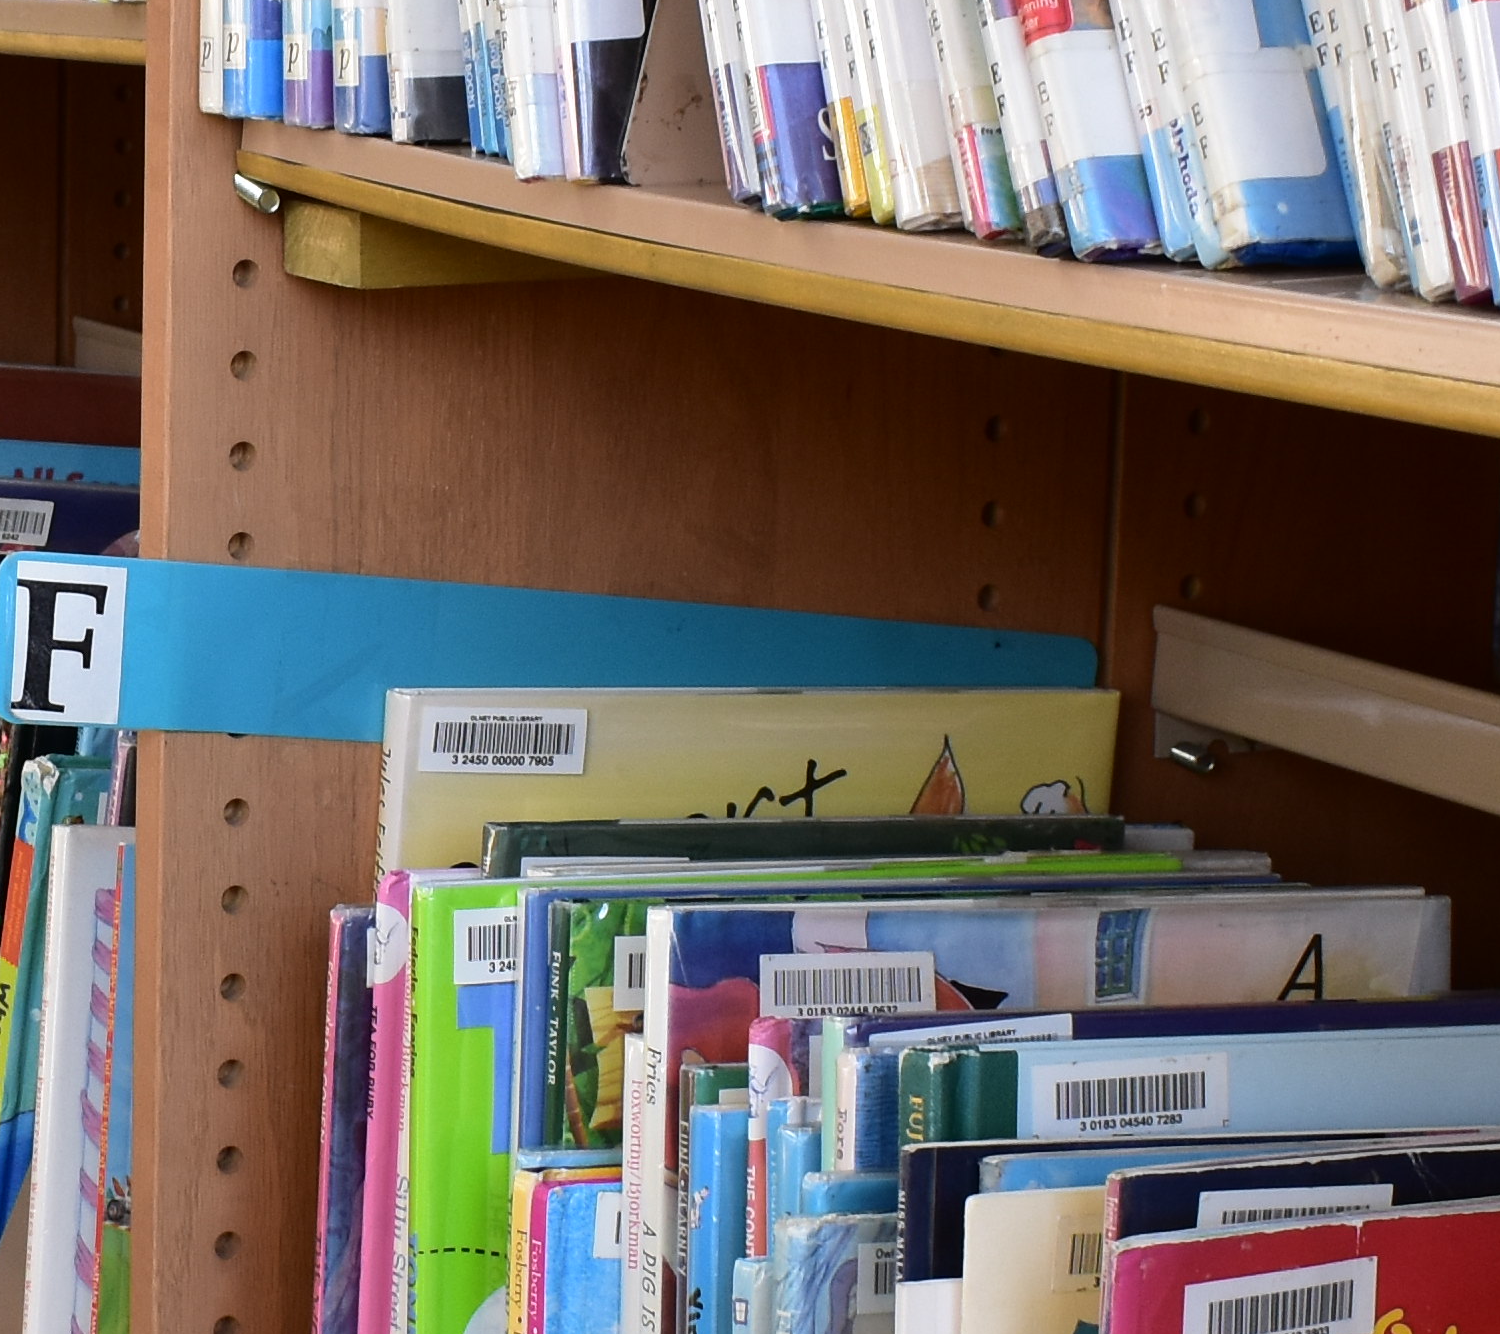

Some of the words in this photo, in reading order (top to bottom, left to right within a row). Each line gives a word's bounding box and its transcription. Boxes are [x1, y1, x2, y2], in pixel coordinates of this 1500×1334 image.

[11, 577, 108, 713] F
[451, 755, 458, 765] 3
[462, 755, 488, 765] 2450
[491, 755, 525, 766] 00000
[528, 756, 553, 767] 7905
[548, 950, 561, 1000] FUNK
[546, 1017, 559, 1085] TAYLOR
[645, 1047, 661, 1105] Fries
[1080, 1121, 1087, 1131] 3
[1090, 1118, 1116, 1130] 0183
[1119, 1116, 1153, 1127] 04540
[1156, 1113, 1182, 1125] 7283
[642, 1221, 654, 1236] A
[511, 1229, 527, 1309] Fosberry
[642, 1251, 654, 1293] PIG
[641, 1305, 653, 1328] IS
